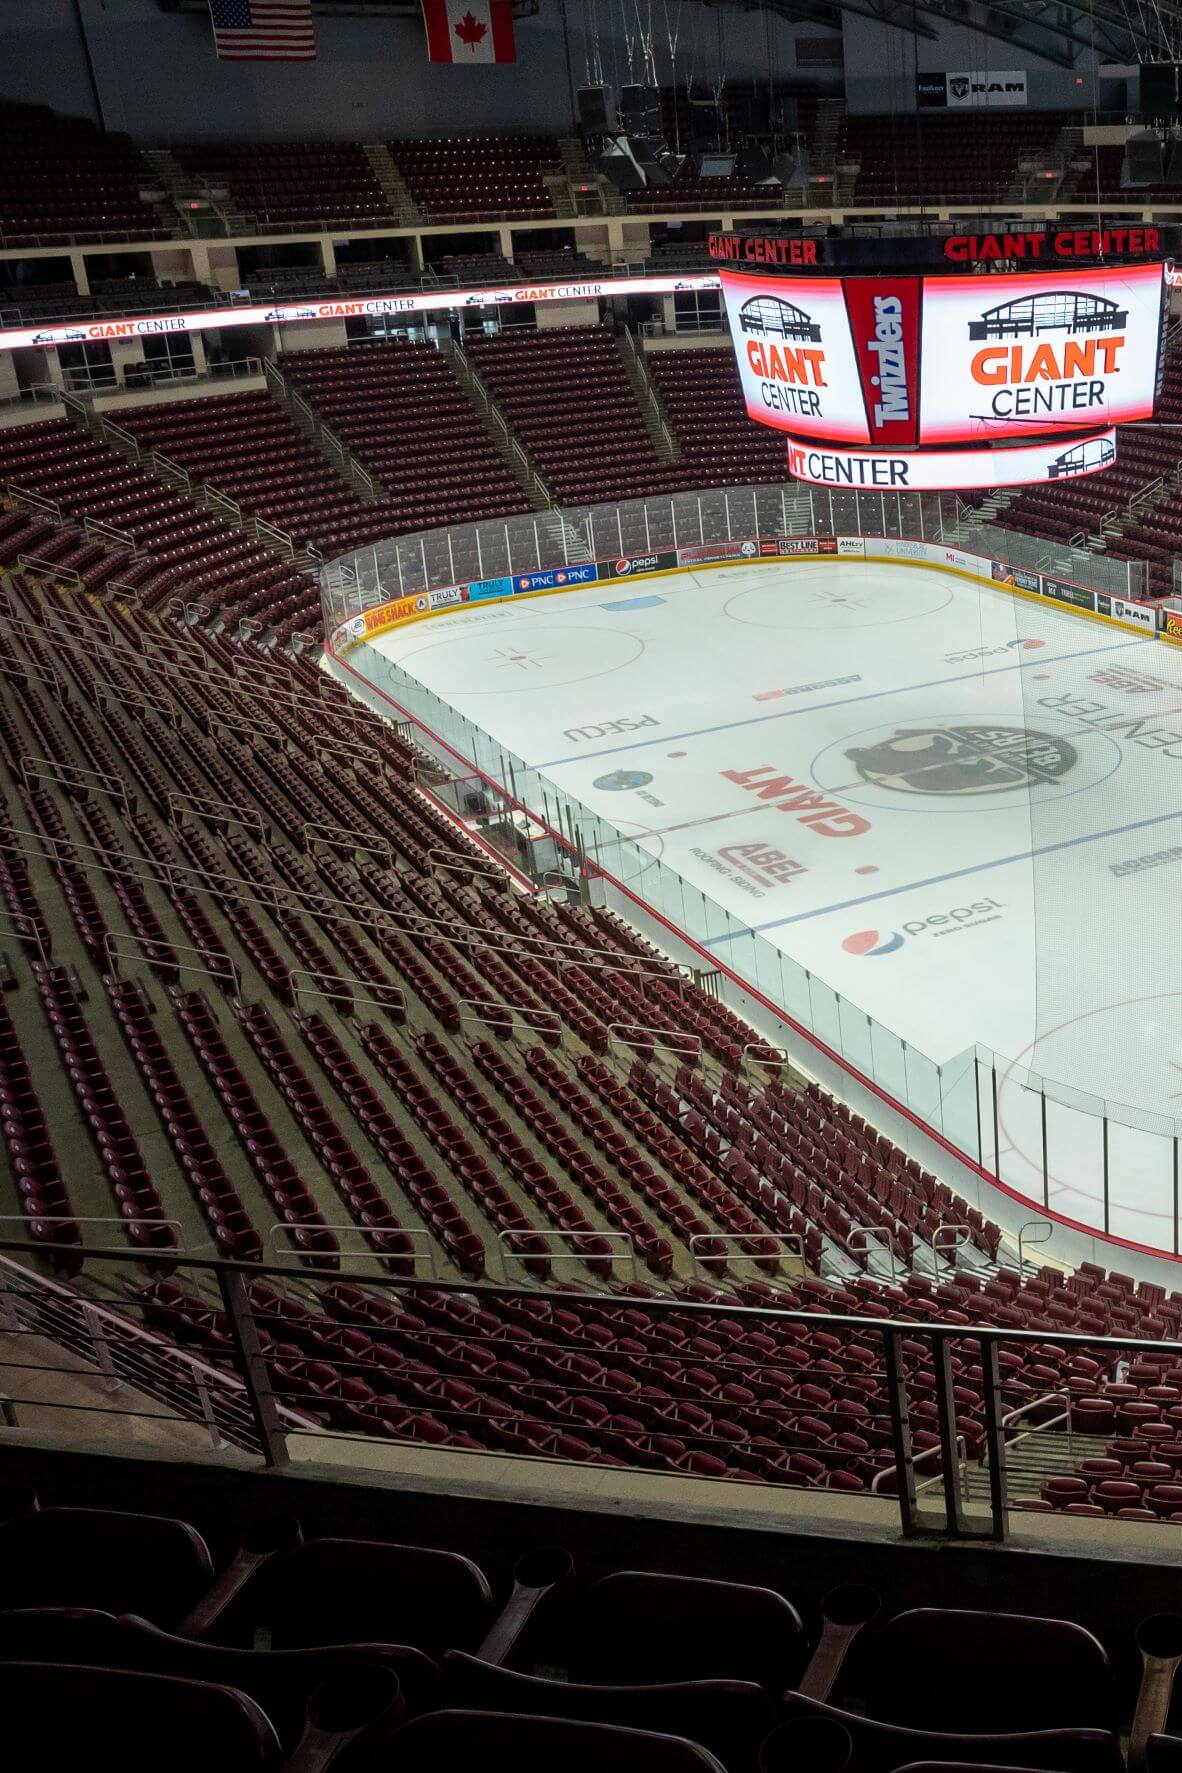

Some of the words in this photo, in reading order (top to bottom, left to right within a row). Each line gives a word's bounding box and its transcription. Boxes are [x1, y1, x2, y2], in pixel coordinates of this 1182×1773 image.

[971, 83, 1025, 93] RAM
[708, 235, 742, 260] GIANT
[744, 238, 817, 265] CENTER
[944, 232, 1047, 262] GIANT
[1053, 227, 1160, 257] CENTER
[514, 287, 557, 301] GIANT
[557, 284, 602, 297] CENTER
[318, 302, 365, 316] GIANT
[366, 299, 415, 313] CENTER
[89, 324, 136, 339] GIANT
[136, 318, 187, 334] CENTER
[747, 340, 828, 390] GIANT
[868, 295, 910, 428] Twizzlers
[969, 335, 1126, 386] GIANT
[760, 382, 824, 418] CENTER
[990, 379, 1106, 418] CENTER
[808, 450, 910, 486] CENTER
[780, 541, 800, 550] BEST
[801, 540, 818, 550] LINE
[567, 570, 590, 580] PNC
[632, 556, 659, 571] pepsi
[431, 589, 459, 602] TRULY
[478, 579, 504, 590] TRULY
[531, 576, 554, 587] PNC
[365, 612, 386, 631] WING
[386, 602, 417, 622] SHACK
[1124, 608, 1150, 622] RAM
[562, 714, 662, 742] PSECU
[718, 764, 872, 838] GIANT
[688, 846, 731, 876] ROOFING
[731, 874, 766, 899] SIDING
[737, 842, 809, 884] ABEL
[902, 896, 1007, 937] pepsi
[932, 925, 963, 938] ZERO
[963, 914, 1004, 928] SUGAR
